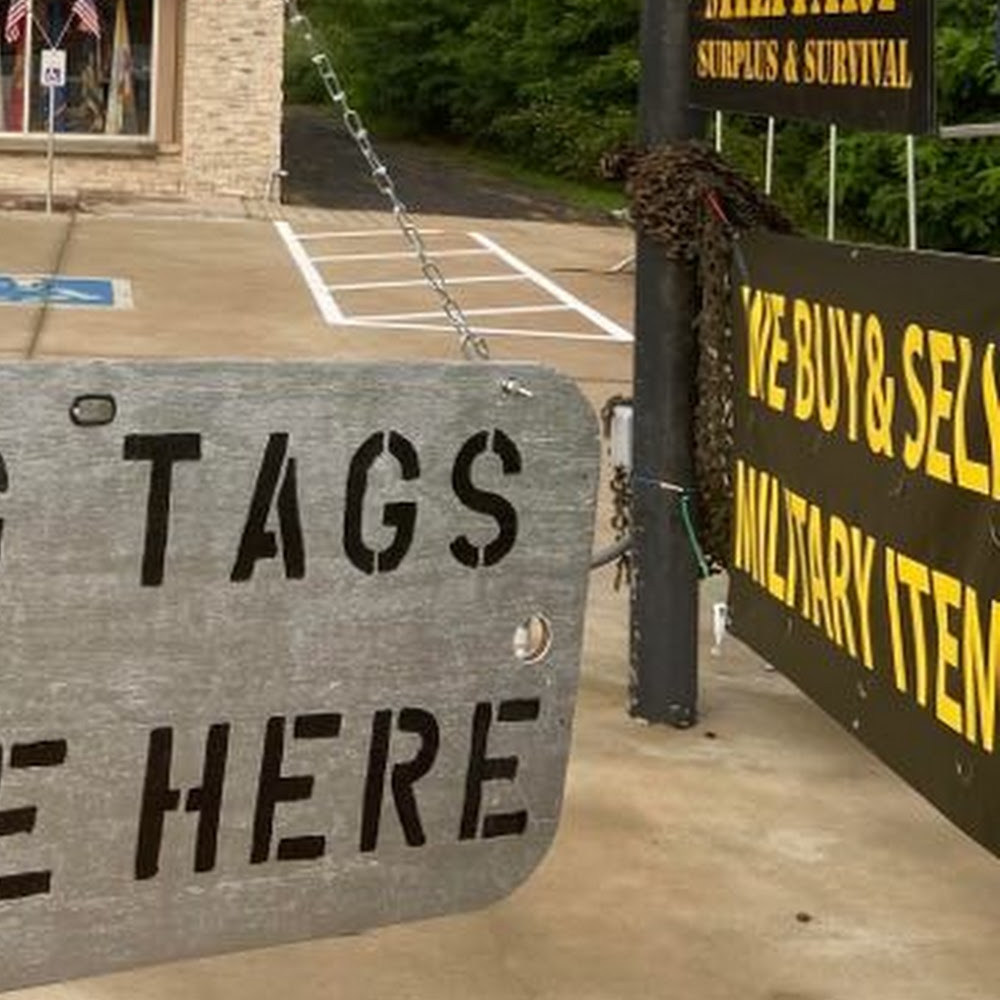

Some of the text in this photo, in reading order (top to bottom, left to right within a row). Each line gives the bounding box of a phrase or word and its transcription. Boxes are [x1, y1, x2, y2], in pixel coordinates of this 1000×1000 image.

[697, 38, 912, 89] SURPLUS & SURVIVAL
[741, 284, 789, 413] WE
[123, 428, 523, 587] TAGS
[735, 458, 876, 672] MILITARY
[134, 696, 541, 882] HERE
